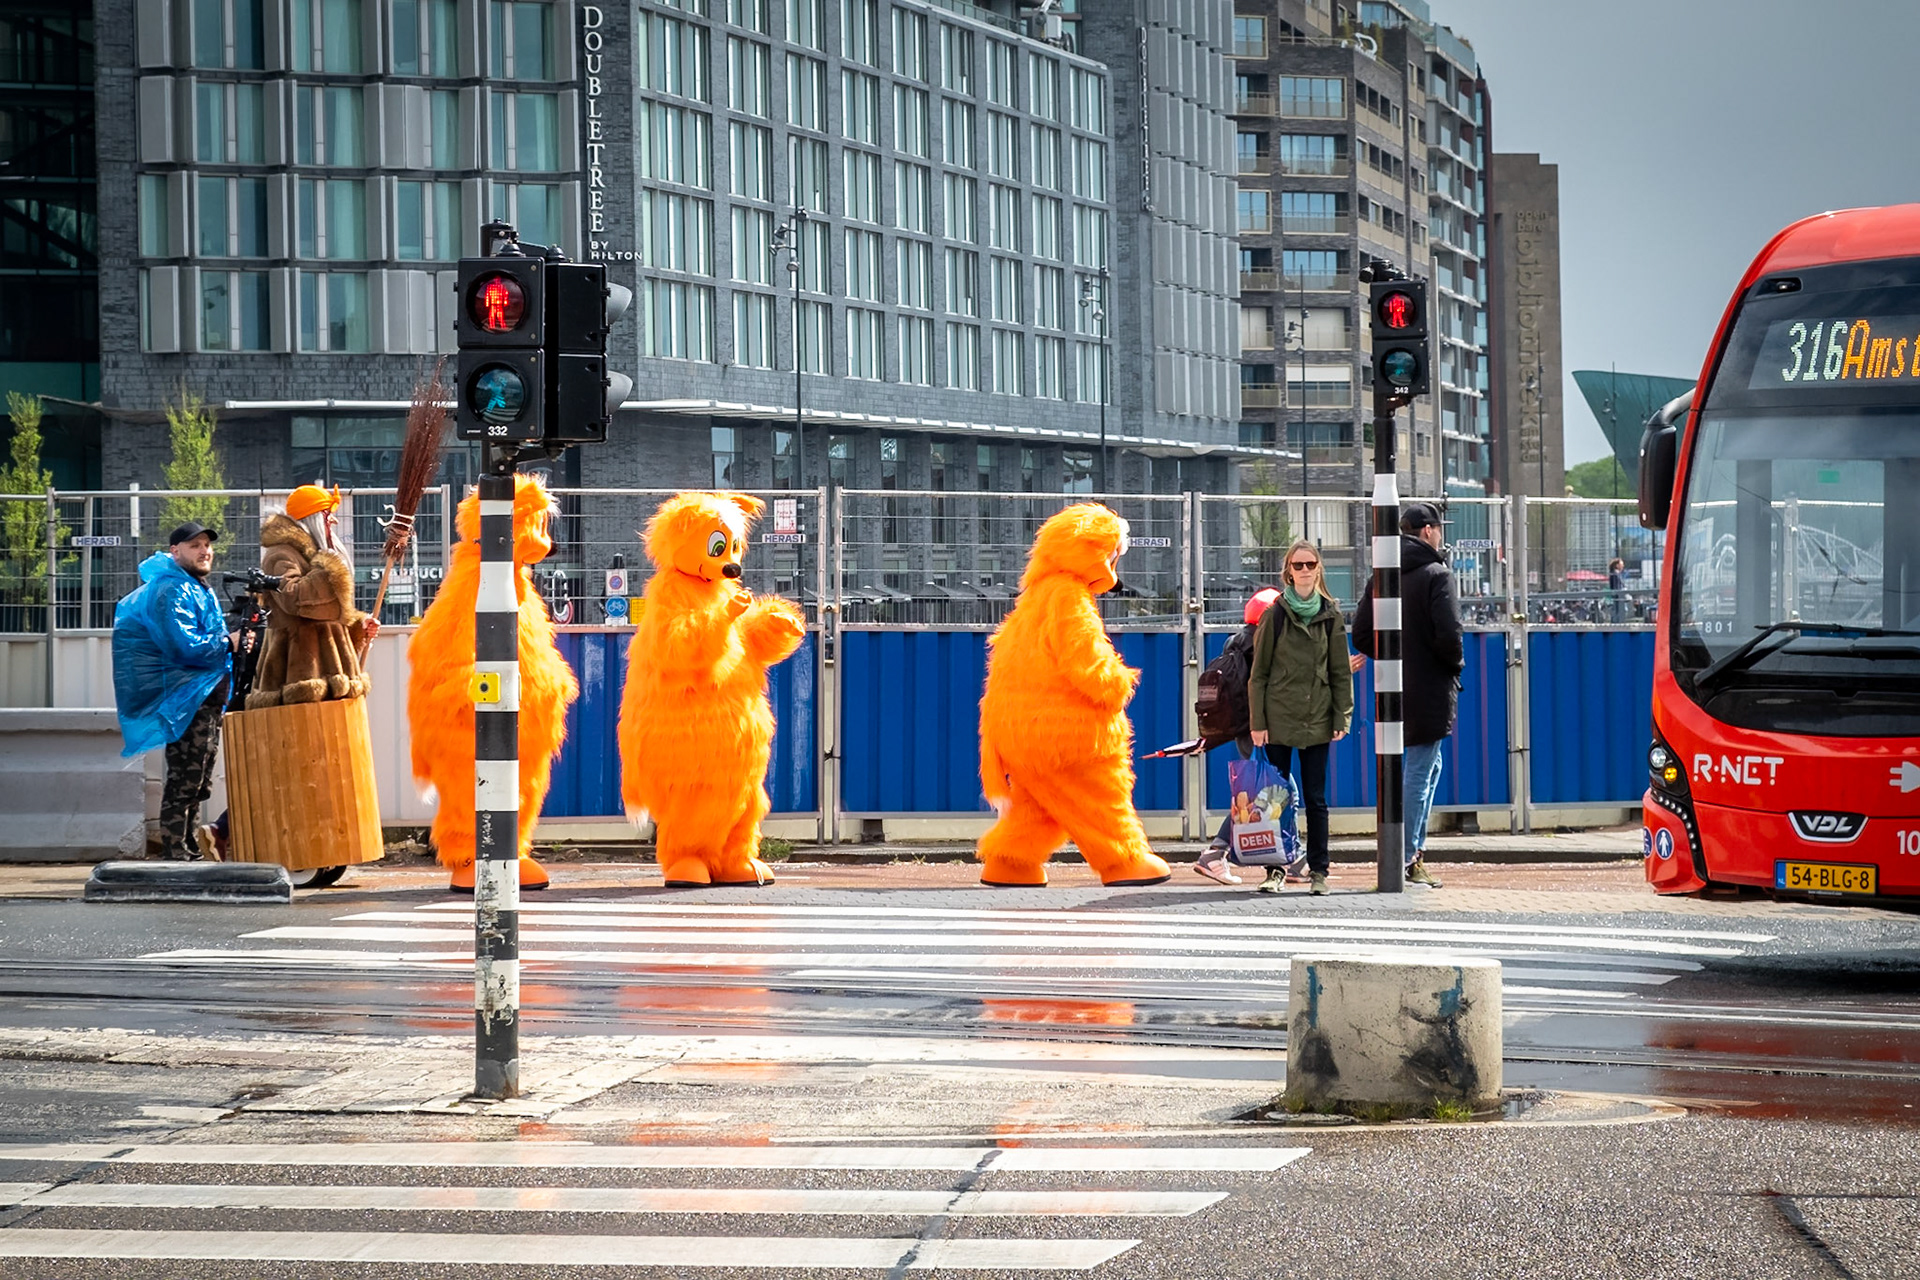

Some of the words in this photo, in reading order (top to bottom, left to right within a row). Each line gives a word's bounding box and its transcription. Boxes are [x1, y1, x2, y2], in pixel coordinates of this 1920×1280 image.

[583, 6, 605, 232] DOUBLETREE
[591, 241, 609, 249] BY
[591, 251, 643, 260] HILTON
[1782, 321, 1848, 381] 316
[1394, 386, 1409, 394] 342
[487, 425, 508, 436] 332
[1705, 621, 1732, 633] 801
[1802, 815, 1853, 833] VDL
[1241, 834, 1273, 848] DEEN
[1897, 830, 1920, 855] 10
[1791, 866, 1870, 889] 54-BLG-8
